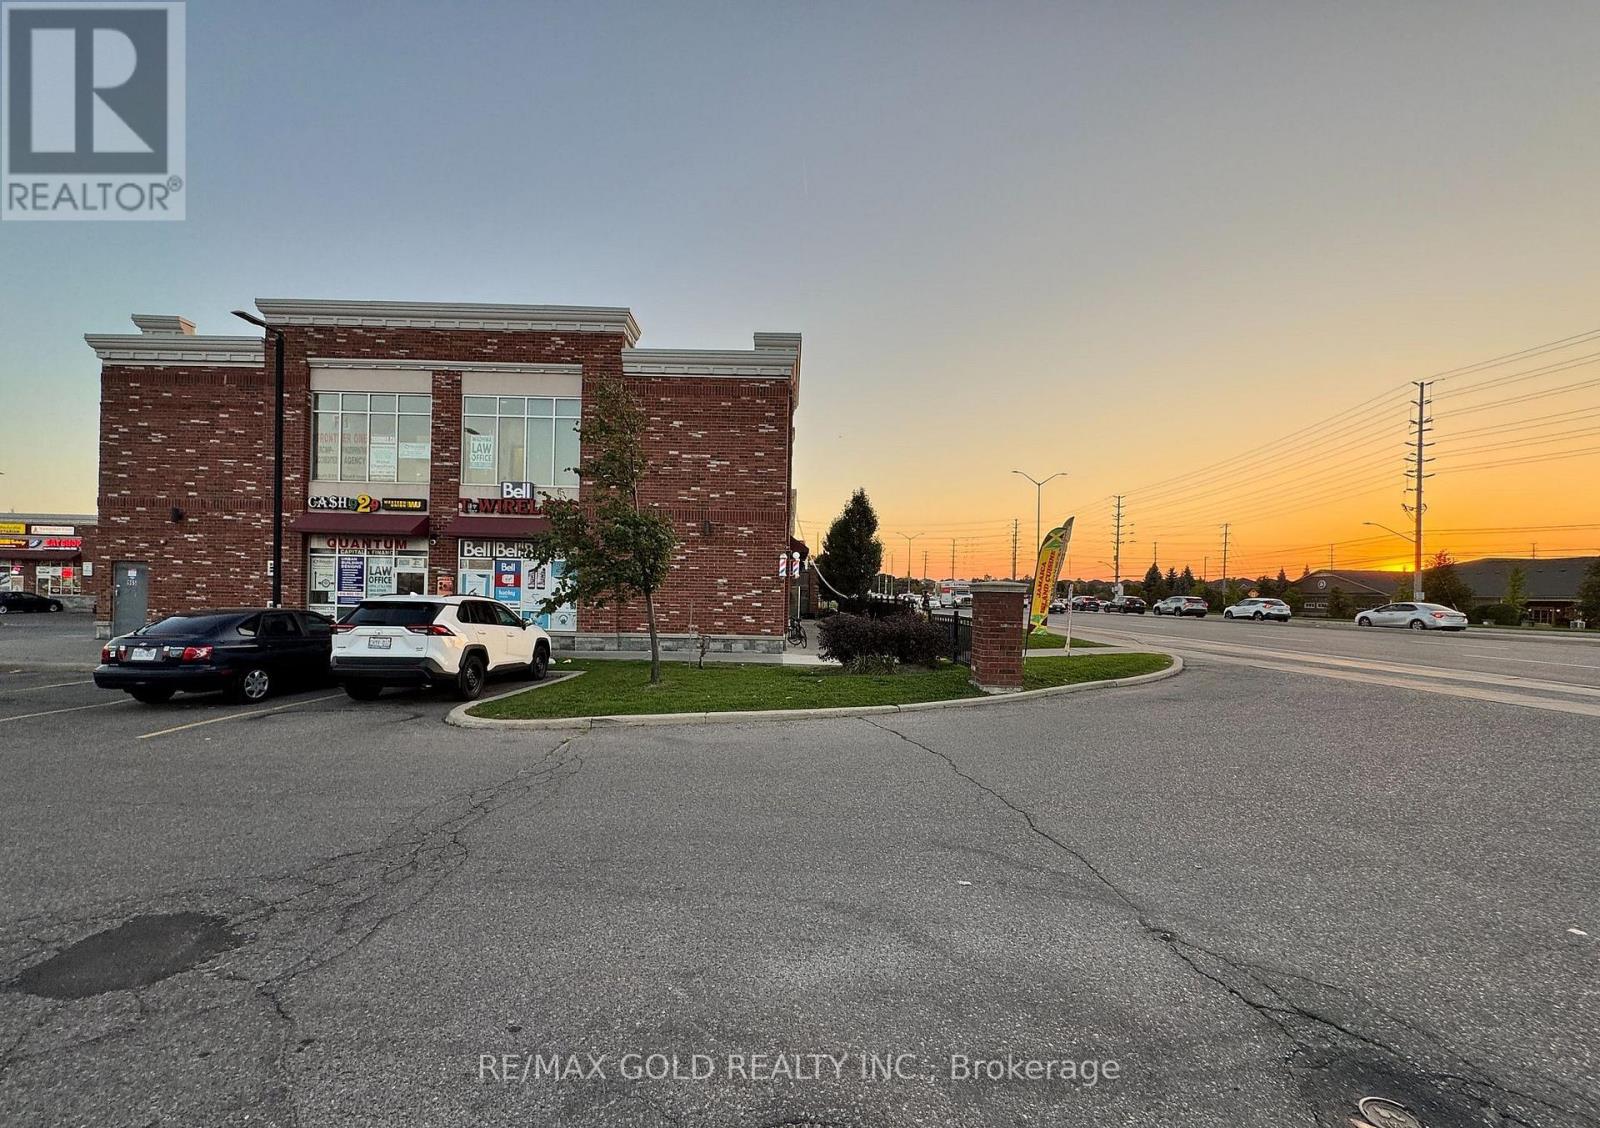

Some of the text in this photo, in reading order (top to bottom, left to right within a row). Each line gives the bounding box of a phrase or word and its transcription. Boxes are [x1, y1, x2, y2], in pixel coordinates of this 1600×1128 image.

[472, 443, 492, 454] LAW
[472, 454, 492, 462] OFFICE
[503, 483, 531, 499] Bell
[327, 538, 407, 549] QUANTUM
[464, 541, 491, 557] Bell
[369, 566, 392, 576] LAW
[501, 563, 516, 571] Bell
[369, 576, 392, 584] OFFICE
[1037, 561, 1047, 598] JAMAICA
[1040, 582, 1050, 614] ISLAND
[1046, 550, 1056, 582] CUISINE
